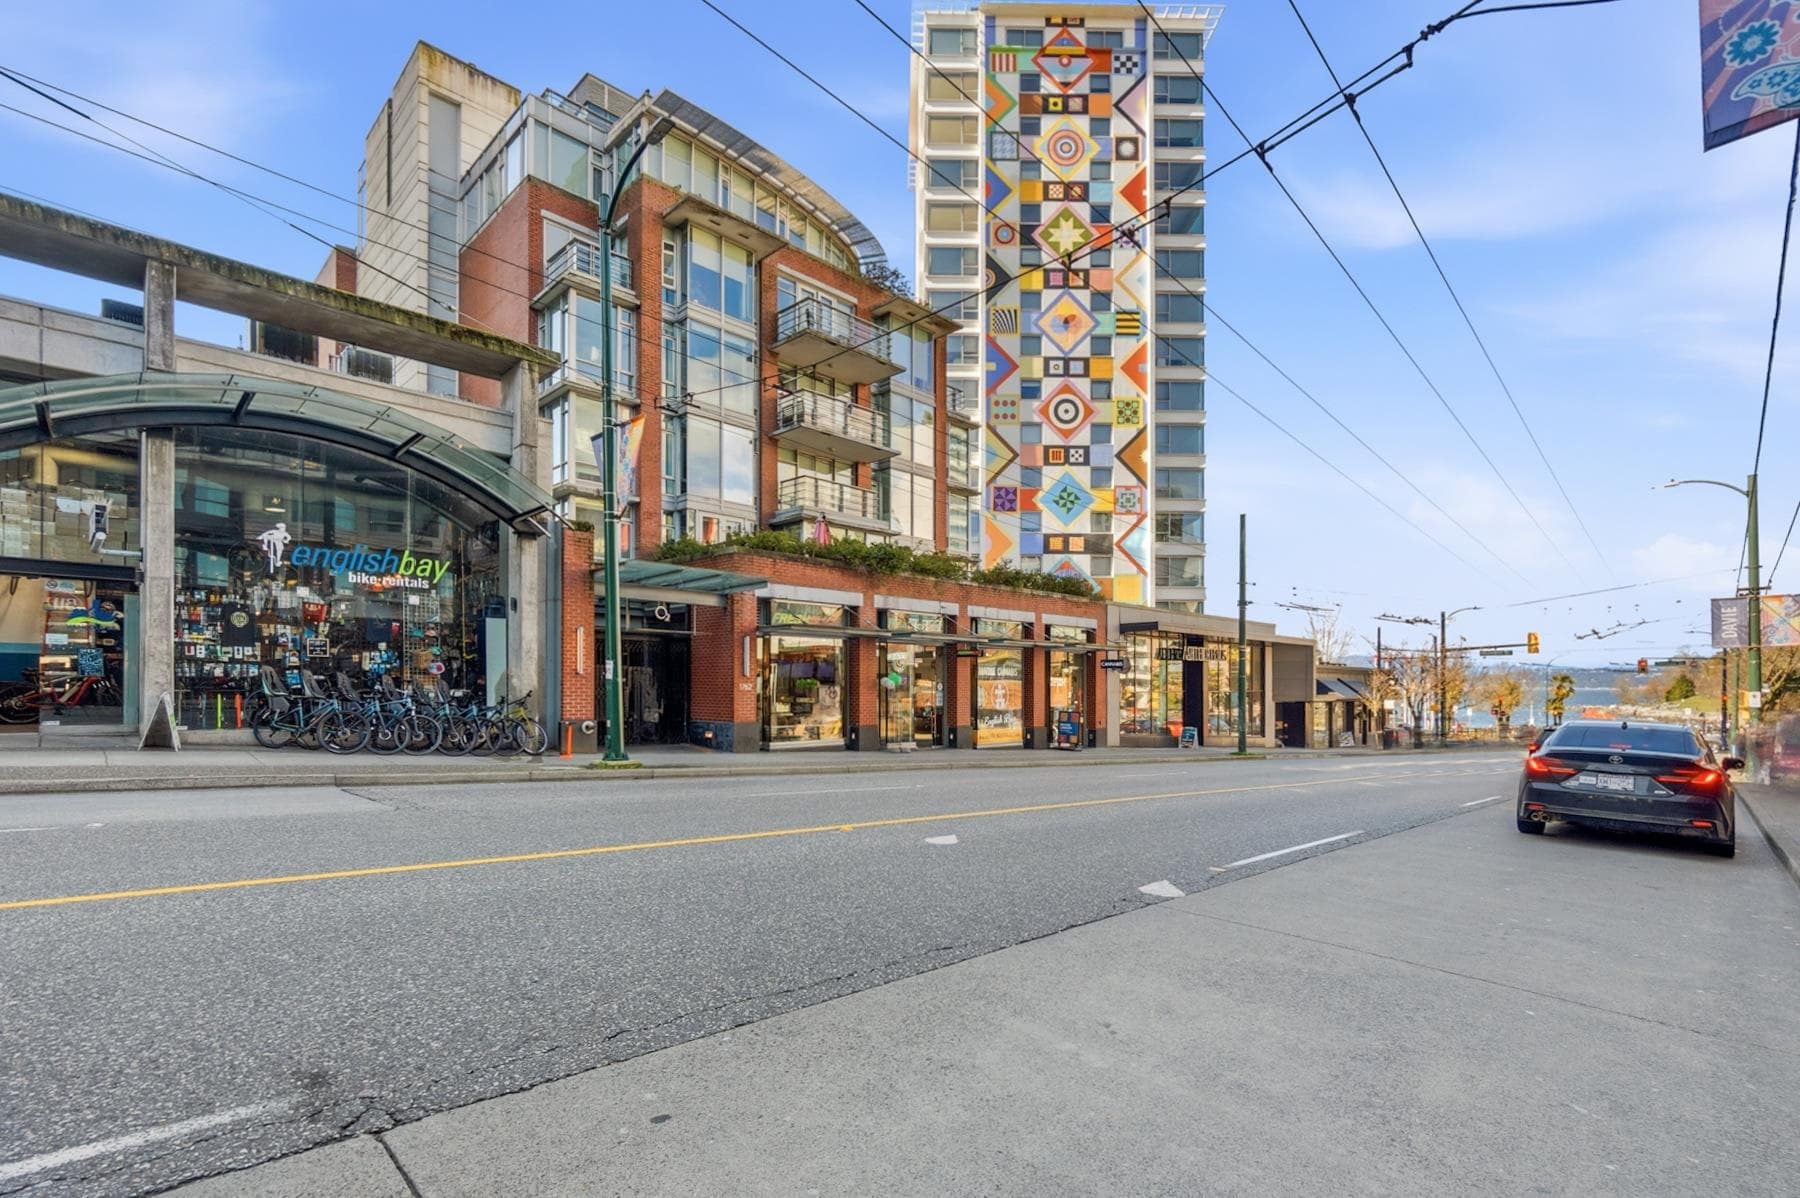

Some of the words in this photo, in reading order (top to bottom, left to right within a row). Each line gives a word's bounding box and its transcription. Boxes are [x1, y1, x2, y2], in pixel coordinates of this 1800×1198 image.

[348, 572, 376, 584] bike
[382, 575, 430, 589] rentals
[1721, 606, 1738, 639] DAVIE
